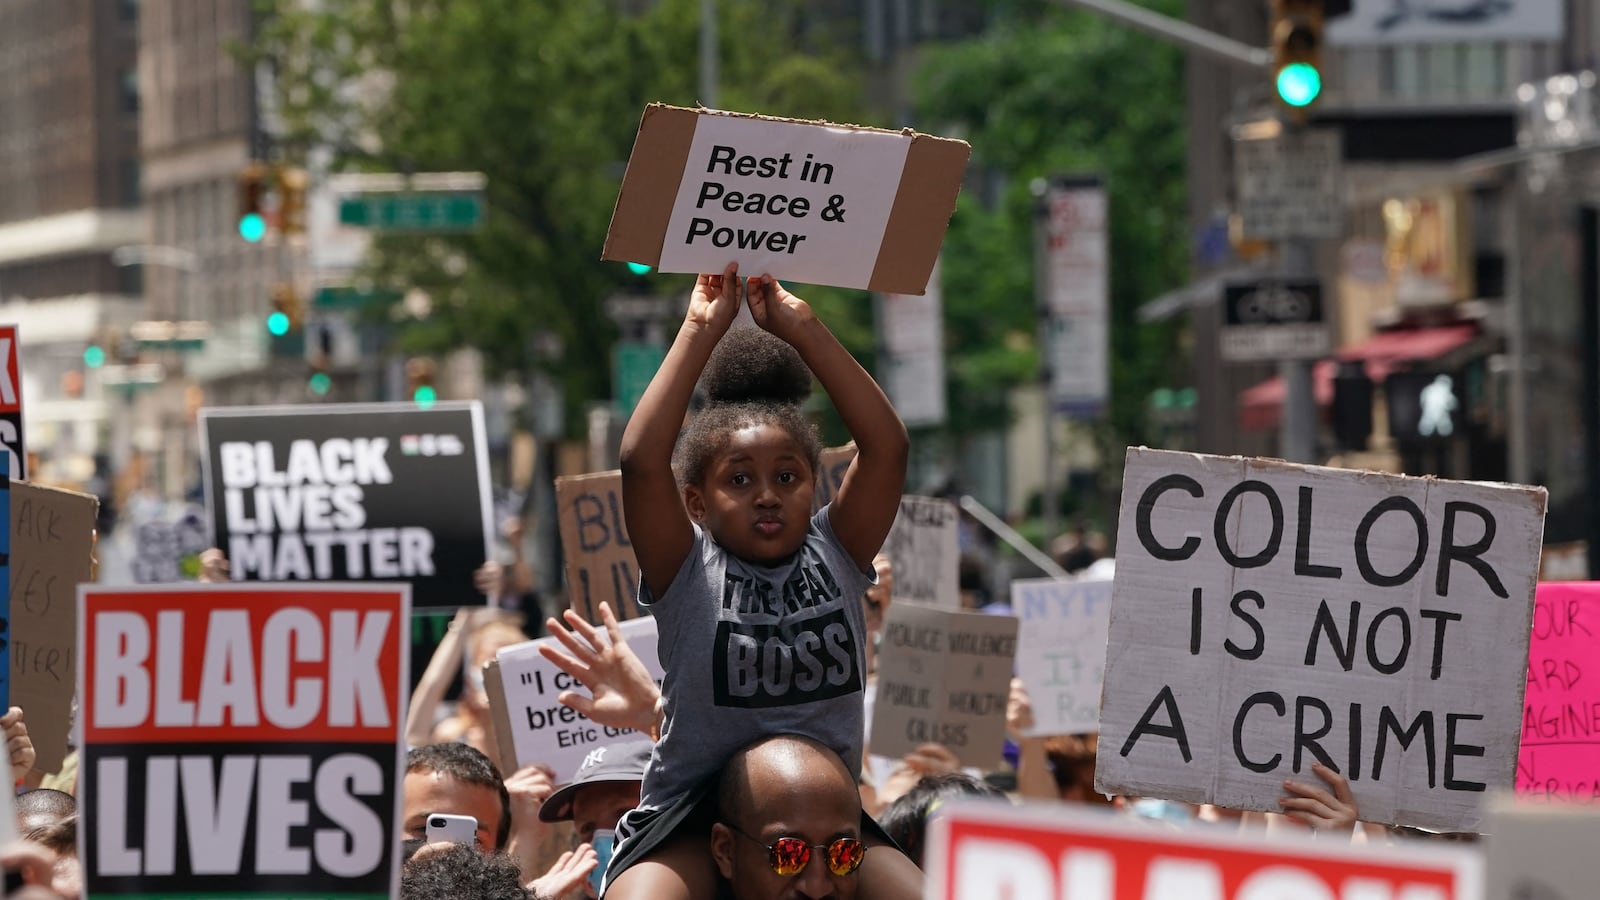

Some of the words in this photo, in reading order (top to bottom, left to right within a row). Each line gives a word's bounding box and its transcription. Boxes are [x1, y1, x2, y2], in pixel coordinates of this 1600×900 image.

[706, 145, 792, 179] Rest
[800, 153, 834, 185] in
[696, 181, 810, 218] Peace
[820, 194, 846, 223] &
[685, 217, 806, 254] Power
[220, 437, 393, 488] BLACK
[224, 484, 367, 535] LIVES
[1135, 474, 1509, 598] COLOR
[229, 526, 436, 582] MATTER
[727, 622, 852, 697] BOSS
[886, 622, 943, 653] POLICE
[1190, 587, 1266, 661] IS
[1304, 598, 1463, 680] NOT
[94, 607, 392, 729] BLACK
[556, 726, 598, 748] Eric
[1120, 685, 1193, 763] A
[1233, 691, 1487, 792] CRIME
[96, 753, 385, 878] LIVES
